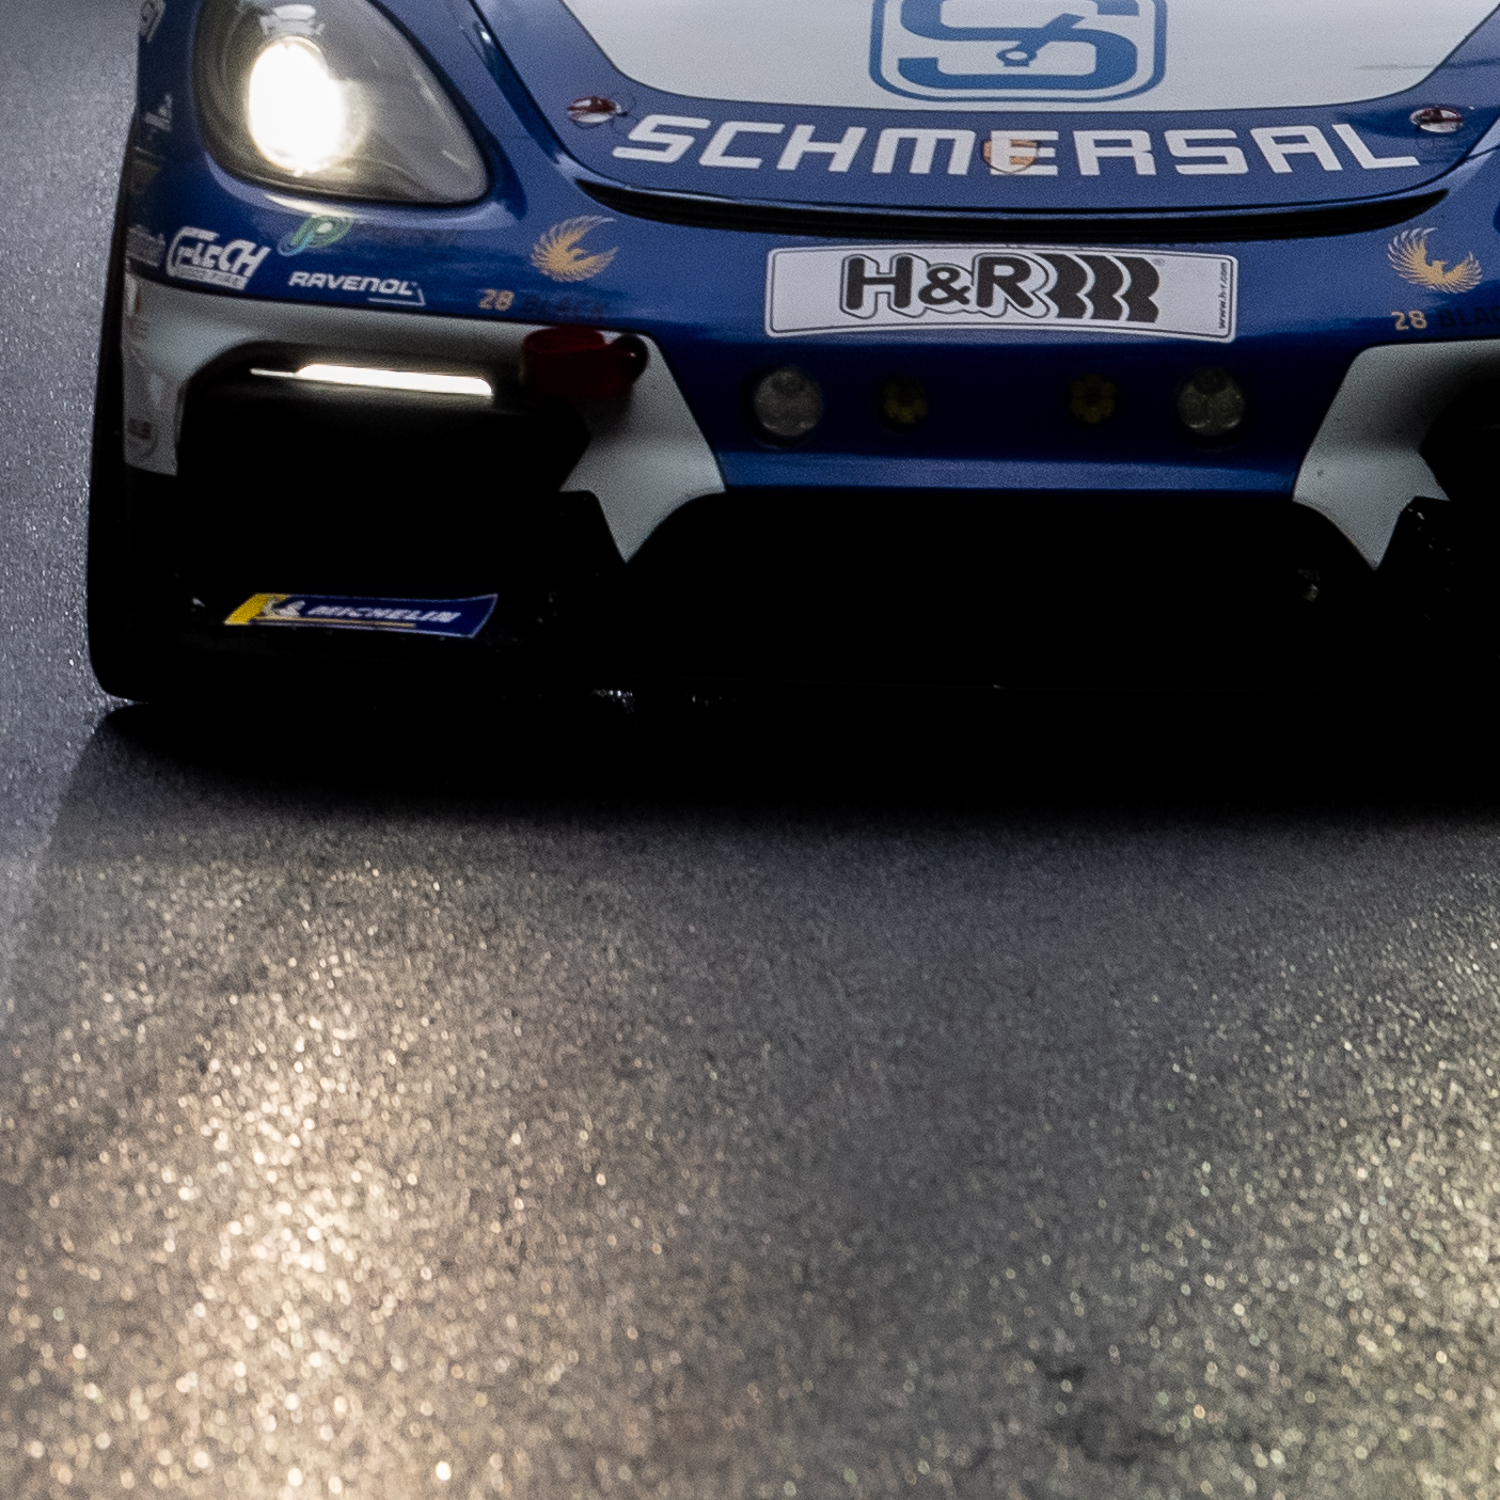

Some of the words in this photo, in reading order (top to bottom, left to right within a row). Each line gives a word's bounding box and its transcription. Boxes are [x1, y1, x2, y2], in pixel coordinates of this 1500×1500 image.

[612, 112, 1421, 176] SCHMERSAL
[288, 270, 416, 297] RAVENOL
[840, 252, 1051, 319] H&R
[478, 288, 516, 311] 28
[1391, 310, 1428, 332] 28
